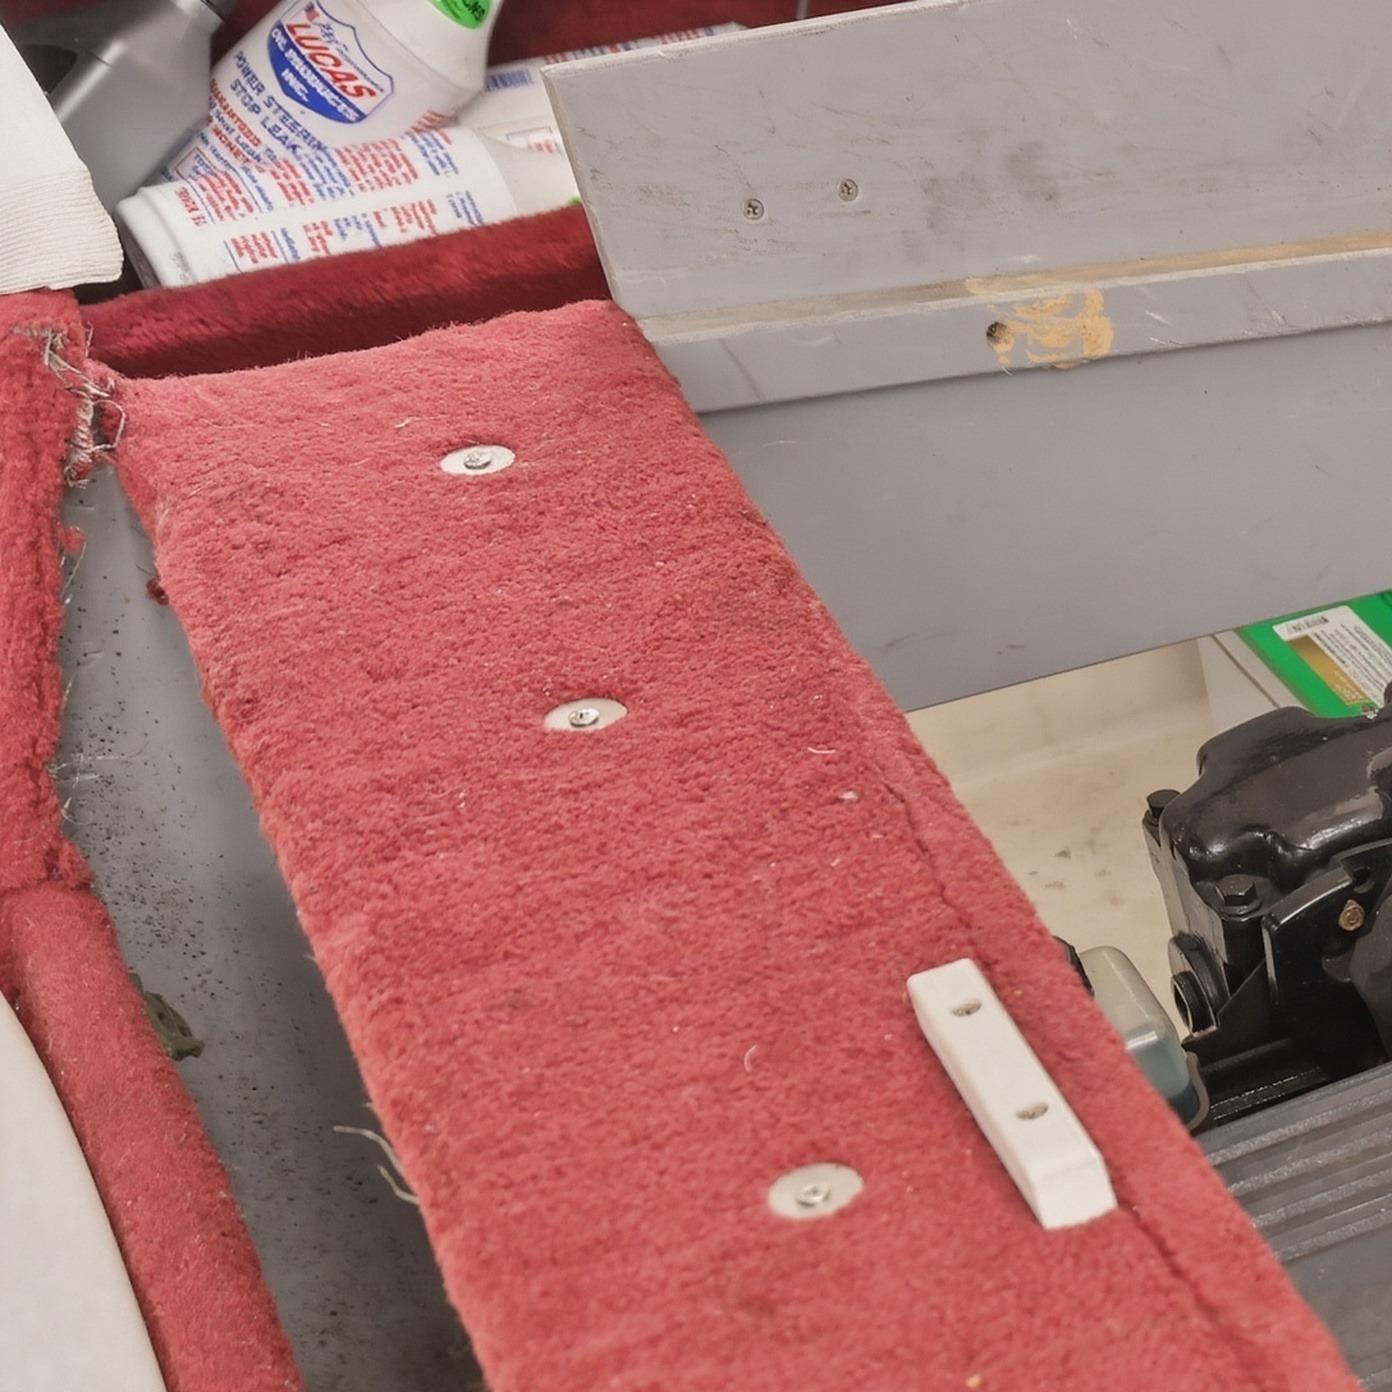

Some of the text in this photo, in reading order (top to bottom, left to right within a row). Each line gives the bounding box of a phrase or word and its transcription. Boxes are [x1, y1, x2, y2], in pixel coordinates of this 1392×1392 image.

[230, 79, 261, 115] STOP
[233, 50, 265, 96] POWER
[263, 95, 328, 151] STEERIN
[271, 27, 288, 52] OIL
[284, 48, 359, 122] PRODUCTS
[286, 23, 376, 97] LUCAS
